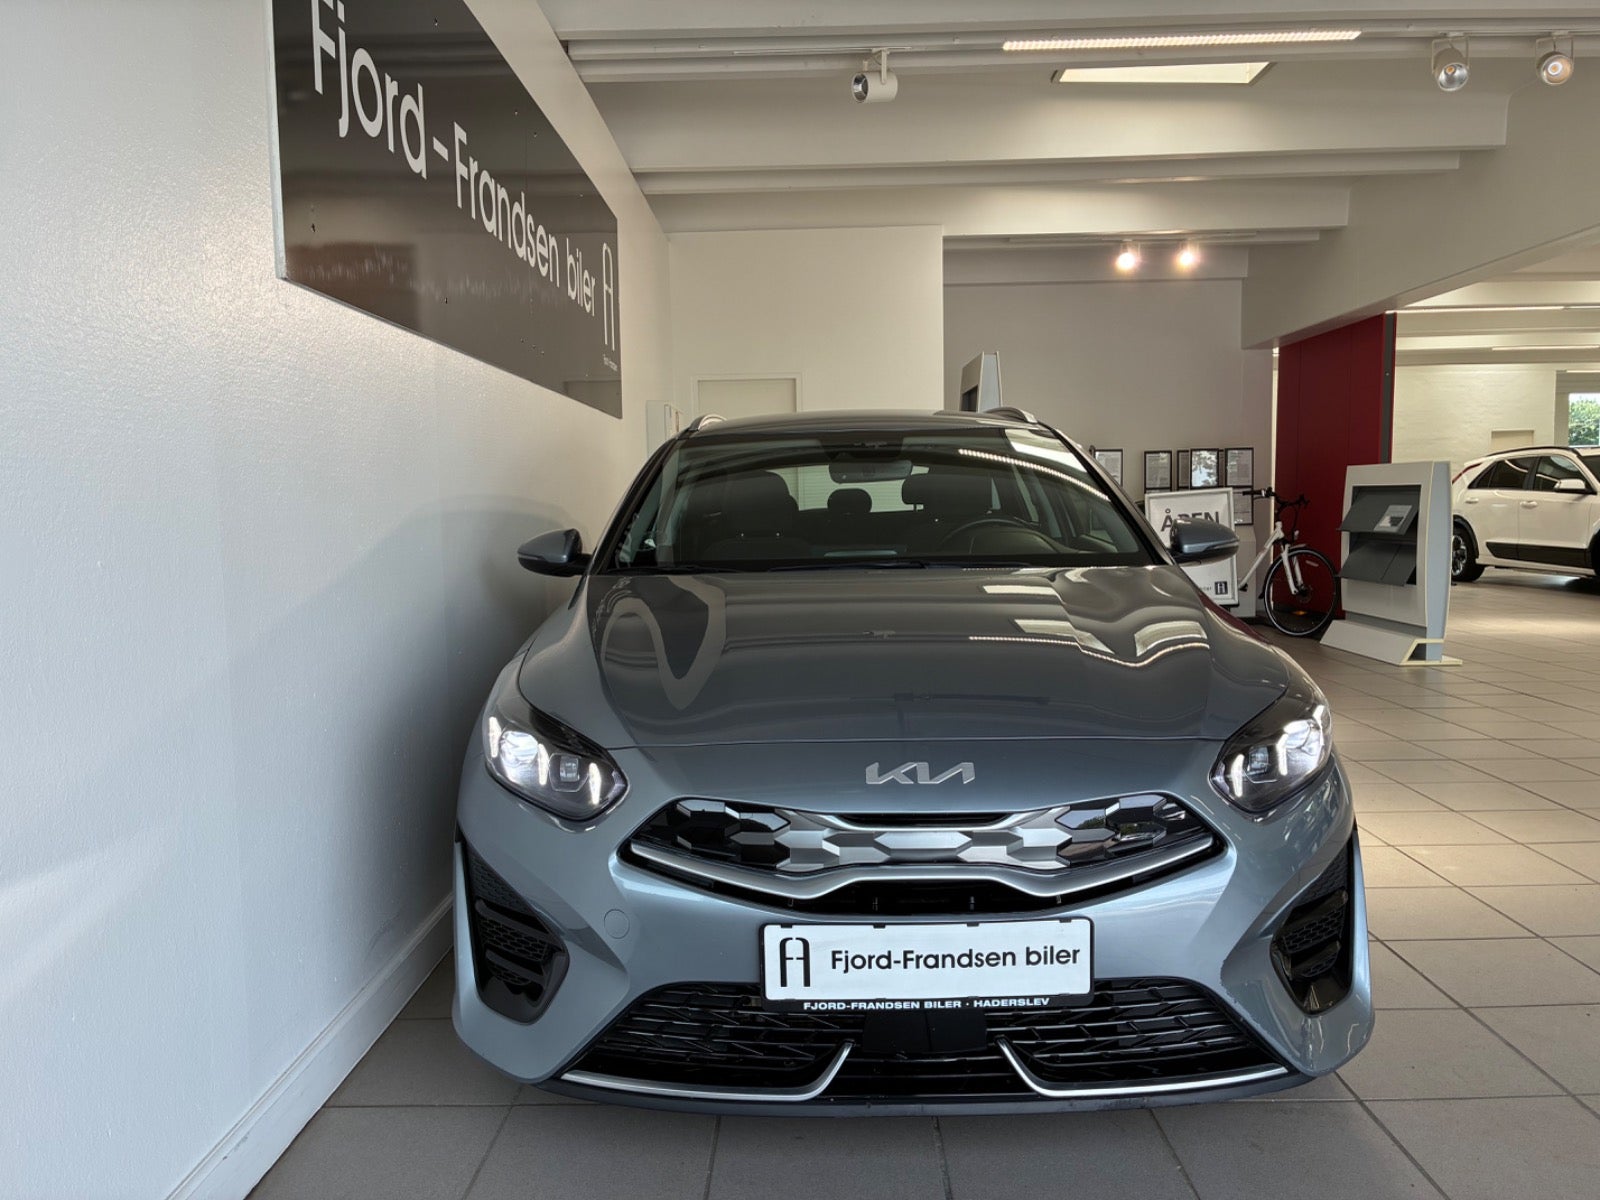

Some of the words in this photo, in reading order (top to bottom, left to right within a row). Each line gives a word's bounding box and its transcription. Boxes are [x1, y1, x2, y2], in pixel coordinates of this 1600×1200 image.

[566, 237, 596, 317] biler
[865, 761, 976, 785] KIA
[831, 948, 1017, 974] Fjord-Frandsen
[1025, 945, 1081, 967] biler
[803, 1000, 920, 1011] FJORD-FRANDSEN
[923, 1000, 962, 1009] BILER
[972, 997, 1050, 1008] HADERSLEV
